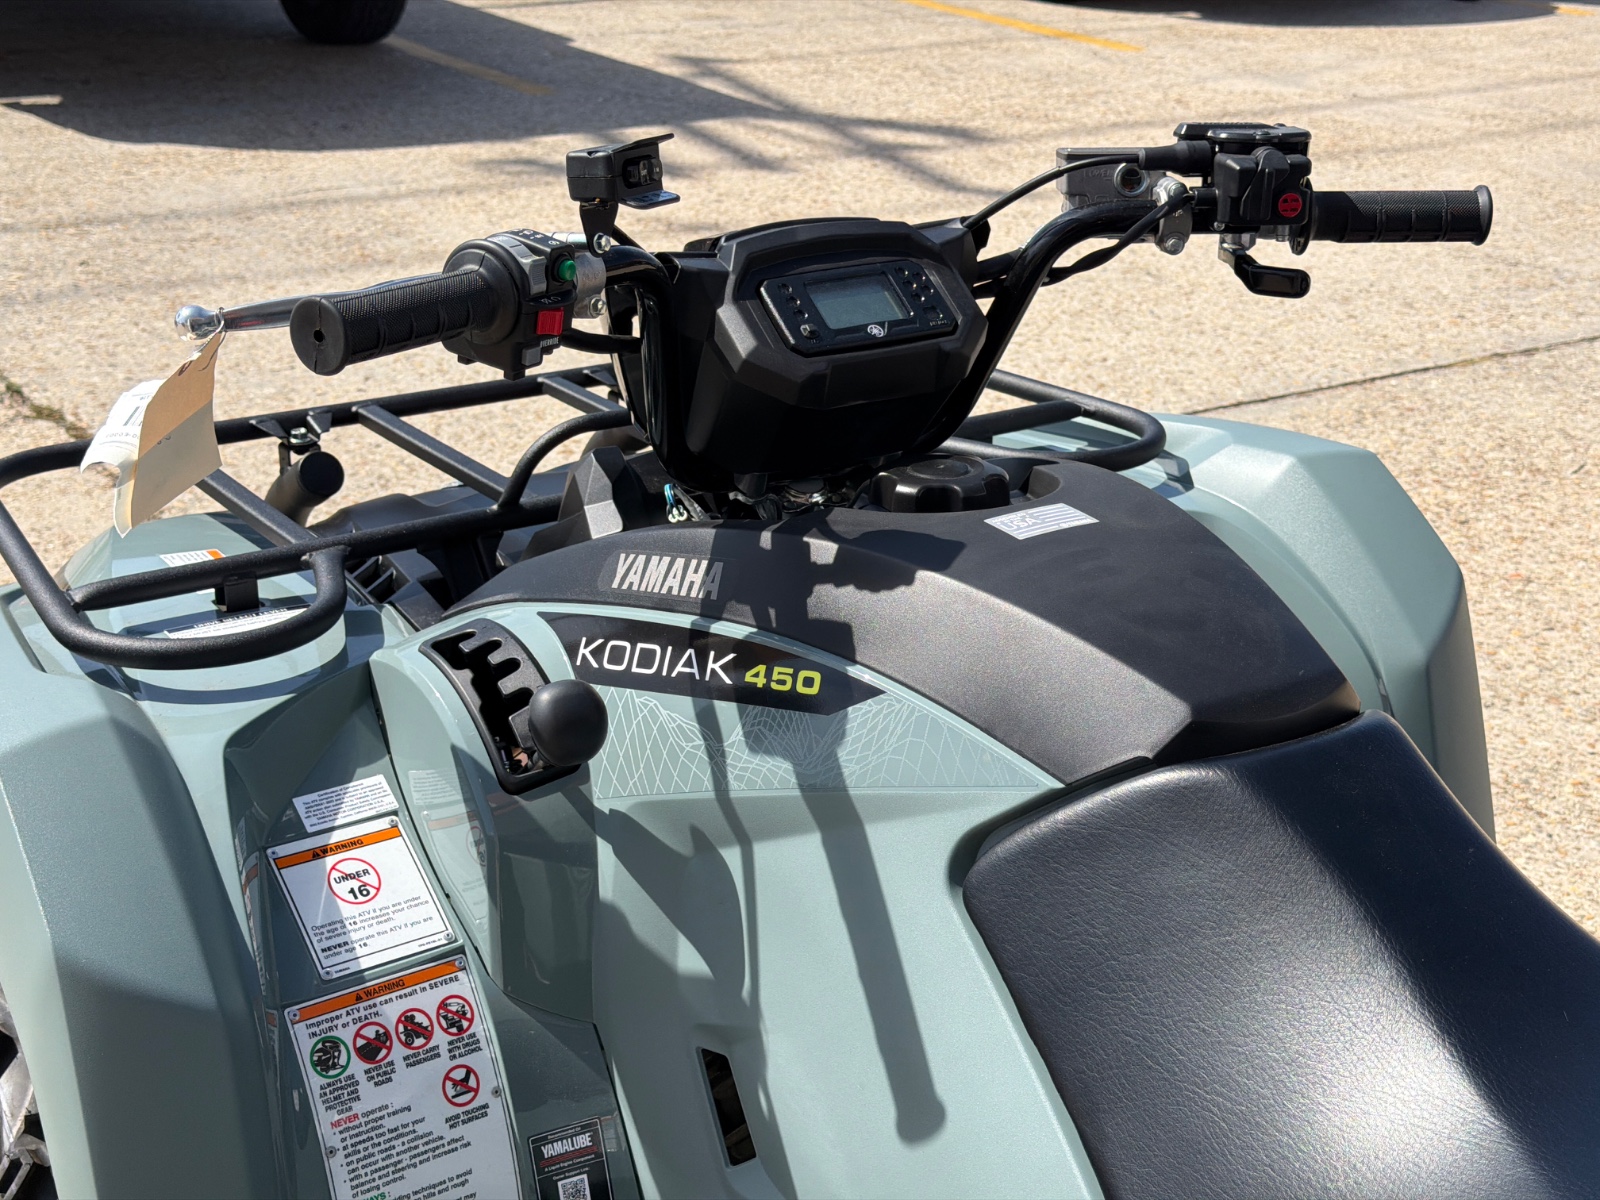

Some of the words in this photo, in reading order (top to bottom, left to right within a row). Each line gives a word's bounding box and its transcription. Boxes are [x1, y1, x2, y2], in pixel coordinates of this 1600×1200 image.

[996, 516, 1042, 531] USA
[611, 553, 724, 600] YAMAHA
[575, 636, 738, 685] KODIAK
[744, 664, 822, 696] 450
[320, 840, 363, 854] WARNING
[334, 869, 370, 884] UNDER
[347, 884, 371, 900] 16
[311, 919, 344, 931] Operating
[403, 896, 420, 904] under
[360, 912, 390, 923] increases
[391, 907, 405, 915] your
[406, 900, 429, 910] chance
[325, 931, 347, 940] severe
[376, 917, 395, 926] death.
[321, 941, 349, 953] NEVER
[351, 934, 375, 944] operate
[324, 951, 342, 959] under
[364, 980, 405, 997] WARNING
[306, 1014, 342, 1029] Improper
[346, 1007, 360, 1017] ATV
[363, 1003, 377, 1011] use
[379, 998, 394, 1006] can
[395, 989, 418, 1001] result
[429, 975, 459, 990] SEVERE
[309, 1024, 338, 1039] INJURY
[352, 1011, 382, 1025] DEATH.
[447, 1045, 461, 1054] WITH
[462, 1039, 480, 1049] DRUGS
[448, 1036, 465, 1046] NEVER
[403, 1052, 421, 1062] NEVER
[422, 1045, 440, 1055] CARRY
[406, 1052, 441, 1068] PASSENGERS
[458, 1046, 483, 1058] ALCOHOL
[364, 1064, 382, 1075] NEVER
[383, 1060, 395, 1069] USE
[376, 1067, 396, 1079] PUBLIC
[320, 1078, 343, 1090] ALWAYS
[343, 1074, 356, 1083] USE
[329, 1080, 360, 1095] APPROVED
[374, 1076, 393, 1087] ROADS
[322, 1092, 345, 1105] HELMET
[347, 1088, 359, 1097] AND
[325, 1095, 361, 1112] PROTECTIVE
[330, 1113, 360, 1129] NEVER
[361, 1104, 389, 1118] operate
[336, 1106, 353, 1116] GEAR
[338, 1122, 363, 1135] without
[364, 1115, 385, 1127] proper
[387, 1105, 412, 1118] training
[445, 1113, 461, 1124] AVOID
[462, 1103, 489, 1117] TOUCHING
[449, 1121, 460, 1130] HOT
[461, 1111, 488, 1125] SURFACES
[349, 1124, 385, 1140] instruction.
[350, 1136, 374, 1148] speeds
[387, 1126, 400, 1134] fast
[411, 1117, 425, 1127] your
[344, 1149, 361, 1159] skills
[383, 1129, 418, 1145] conditions.
[356, 1152, 376, 1165] public
[377, 1145, 396, 1155] roads
[407, 1131, 434, 1144] collision
[542, 1133, 592, 1158] YAMALUBE
[347, 1167, 360, 1175] can
[361, 1159, 379, 1170] occur
[381, 1154, 395, 1162] with
[396, 1144, 420, 1157] another
[421, 1136, 445, 1147] vehicle.
[349, 1174, 363, 1182] with
[370, 1159, 403, 1176] passenger
[409, 1143, 445, 1162] passengers
[447, 1135, 464, 1146] affect
[350, 1178, 376, 1191] balance
[378, 1171, 390, 1180] and
[391, 1162, 418, 1175] steering
[419, 1156, 431, 1165] and
[432, 1147, 458, 1160] increase
[460, 1141, 471, 1149] risk
[360, 1184, 380, 1195] losing
[382, 1174, 406, 1187] control.
[412, 1180, 446, 1196] techniques
[456, 1168, 472, 1179] avoid
[438, 1185, 449, 1195] and
[451, 1179, 469, 1189] rough
